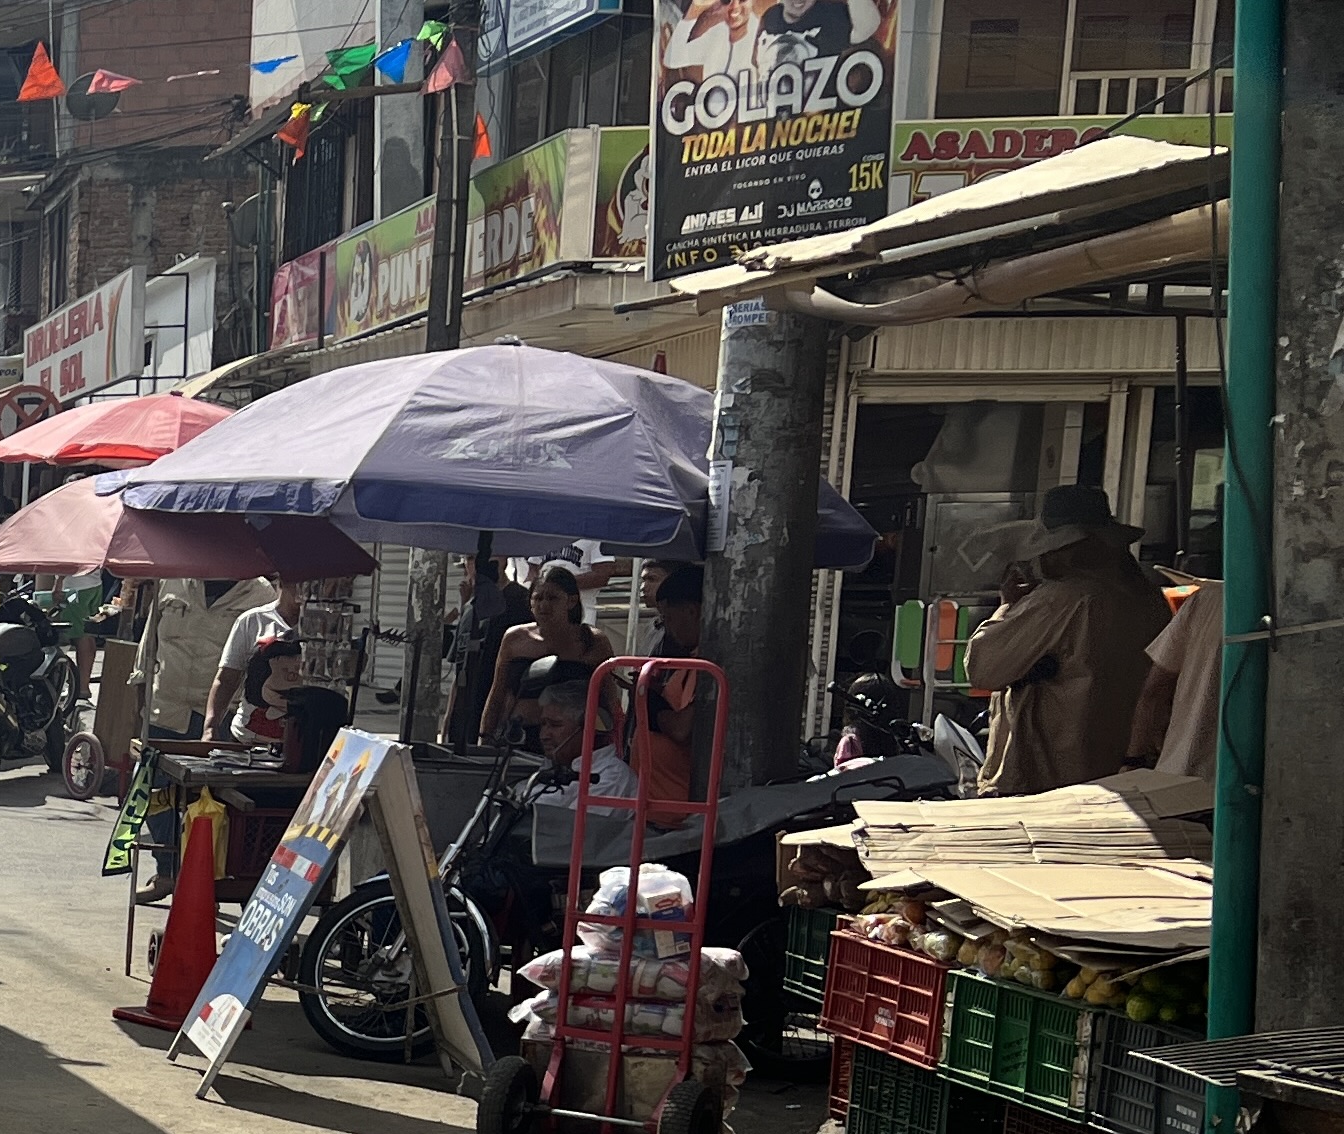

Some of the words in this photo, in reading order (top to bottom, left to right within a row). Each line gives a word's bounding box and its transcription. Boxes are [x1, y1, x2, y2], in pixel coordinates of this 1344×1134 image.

[662, 50, 884, 136] GOLAZO
[681, 127, 737, 164] TODA
[740, 123, 766, 154] LA
[770, 108, 862, 150] NOCHE!
[685, 163, 718, 178] ENTRA
[721, 160, 733, 171] EL
[735, 155, 766, 169] LICOR
[769, 151, 792, 165] QUE
[795, 144, 845, 160] QUIERAS
[848, 160, 884, 192] 15K
[665, 238, 700, 252] CANCHA
[702, 231, 749, 246] SINTÉTICA
[750, 229, 762, 240] LA
[765, 222, 822, 238] HERRADURA
[681, 207, 736, 234] ANDRES
[666, 248, 718, 270] INFO
[60, 351, 86, 397] SOL
[277, 893, 297, 917] SON
[238, 900, 284, 951] OBRAS
